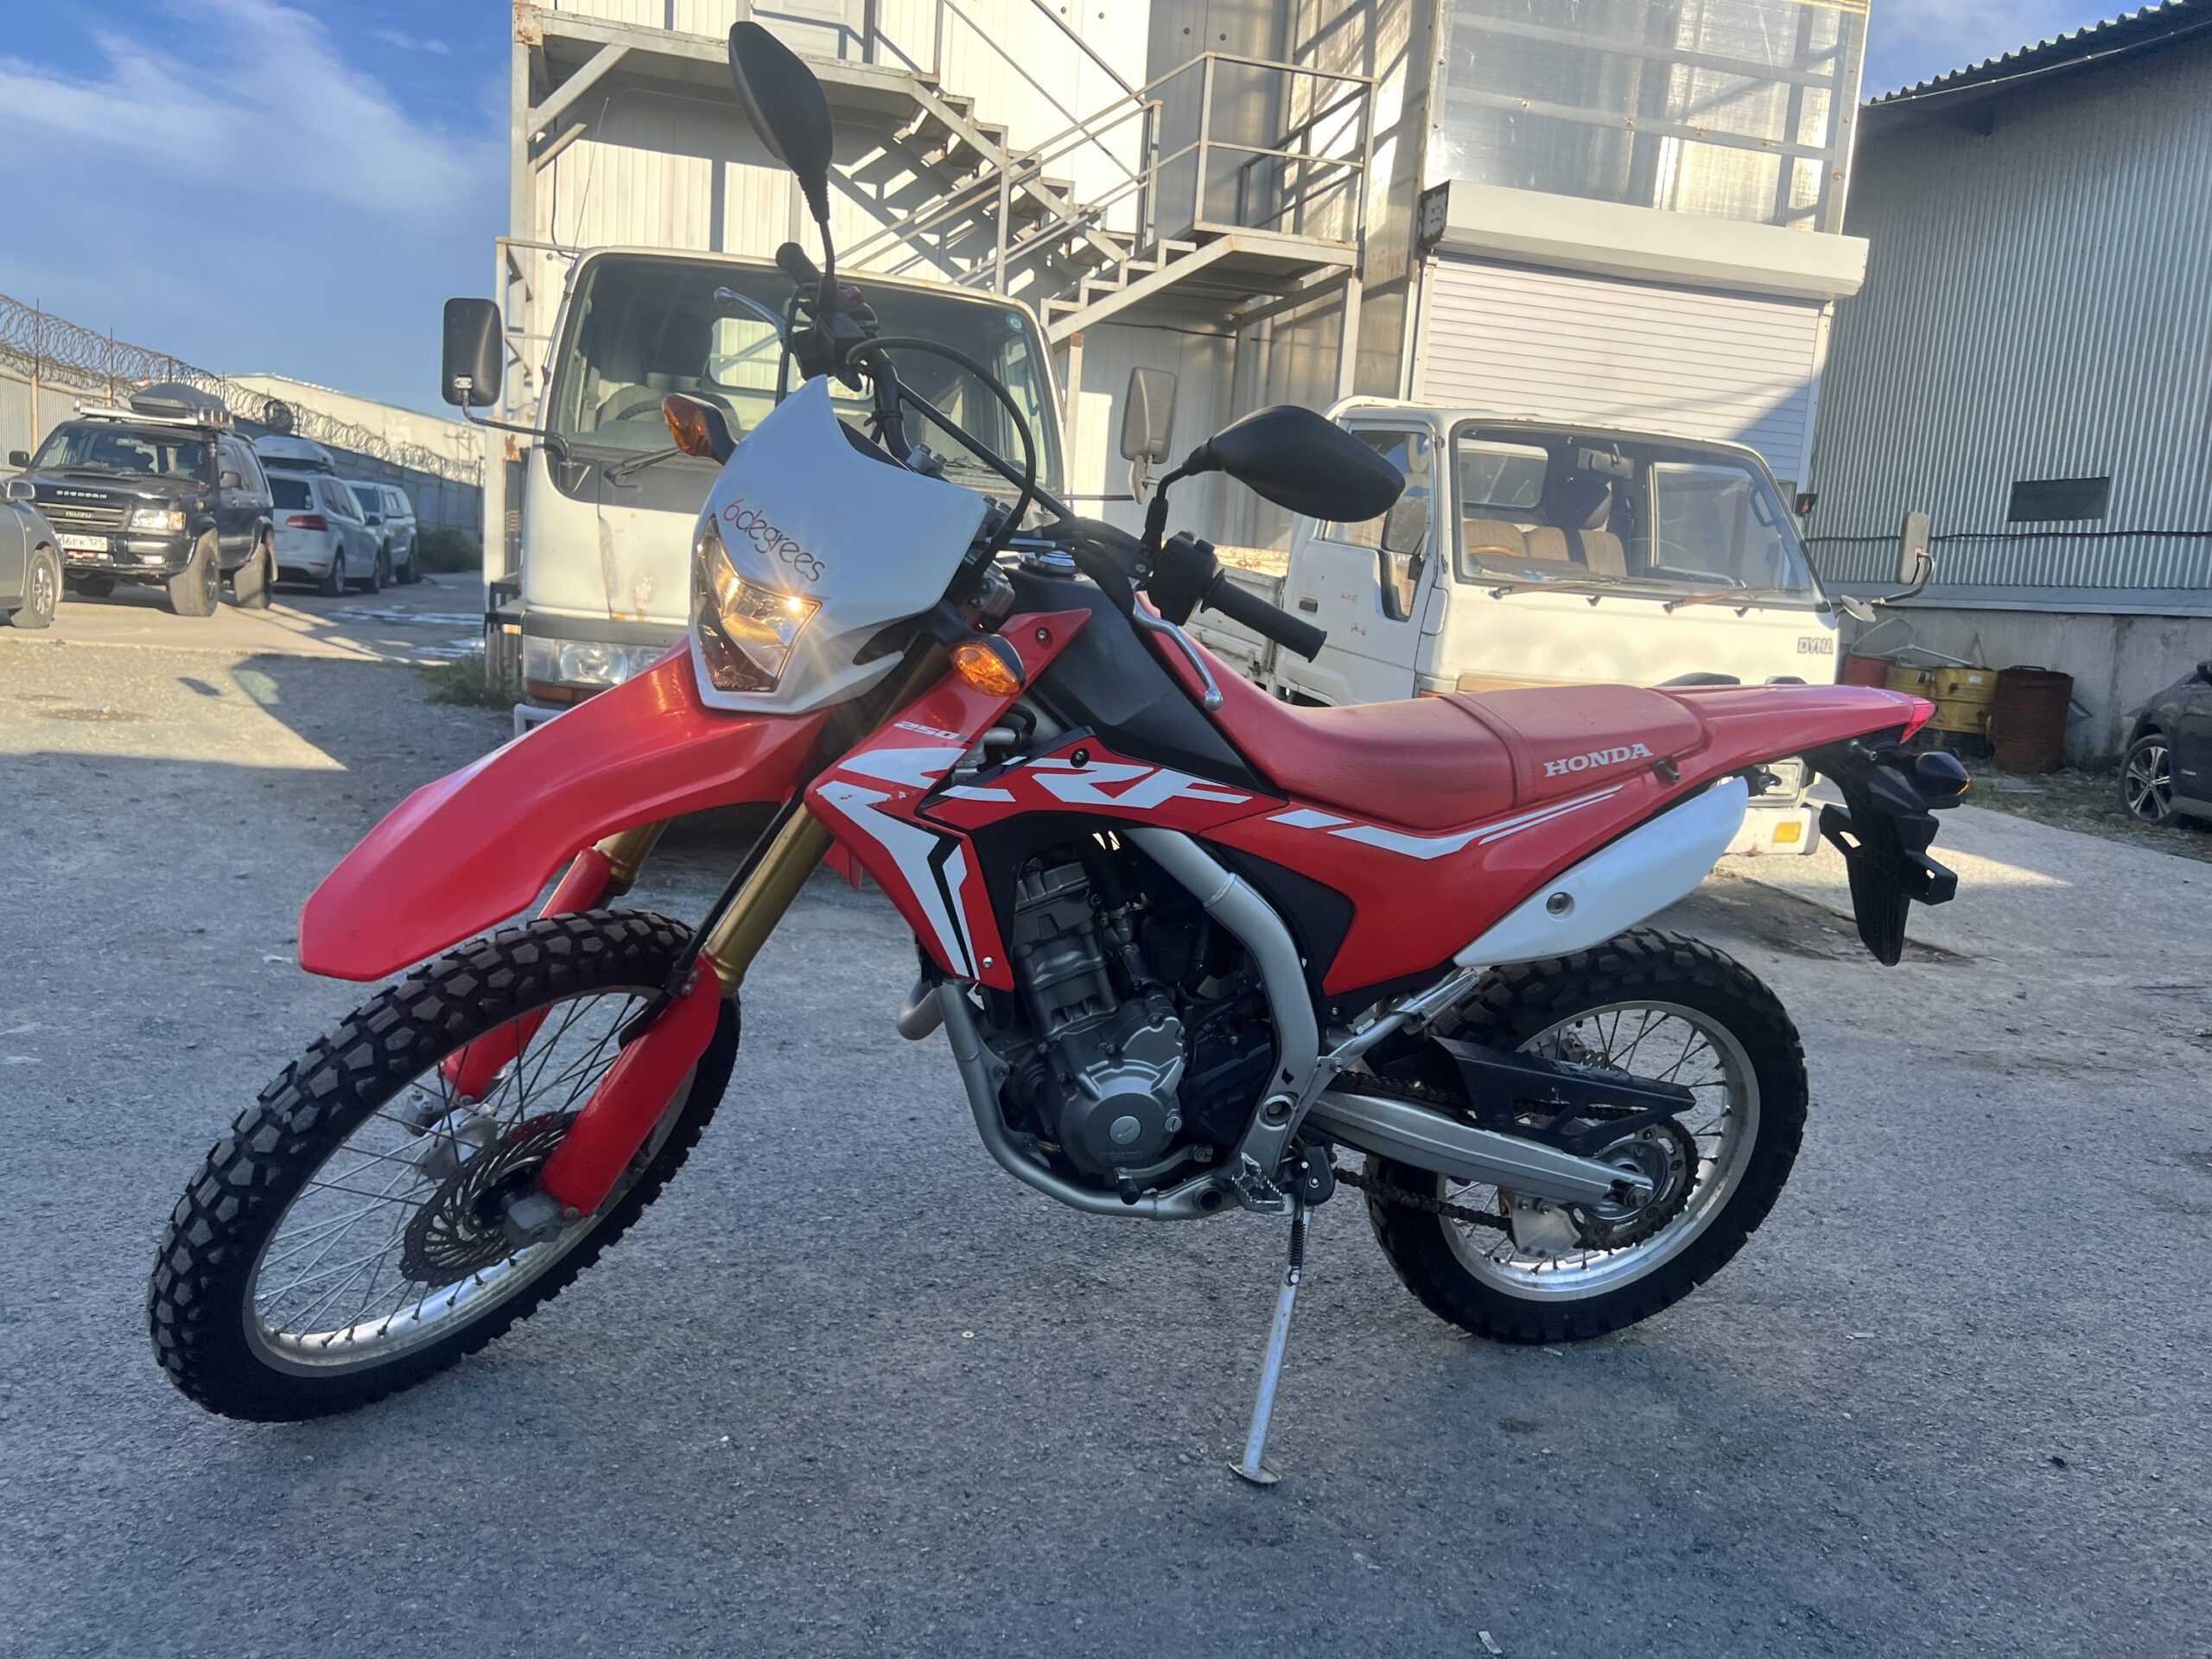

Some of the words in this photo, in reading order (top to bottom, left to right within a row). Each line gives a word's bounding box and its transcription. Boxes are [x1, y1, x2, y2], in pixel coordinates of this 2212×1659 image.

[723, 499, 825, 582] 6degrees
[1797, 637, 1834, 654] DYNA
[1543, 743, 1654, 777] HONDA
